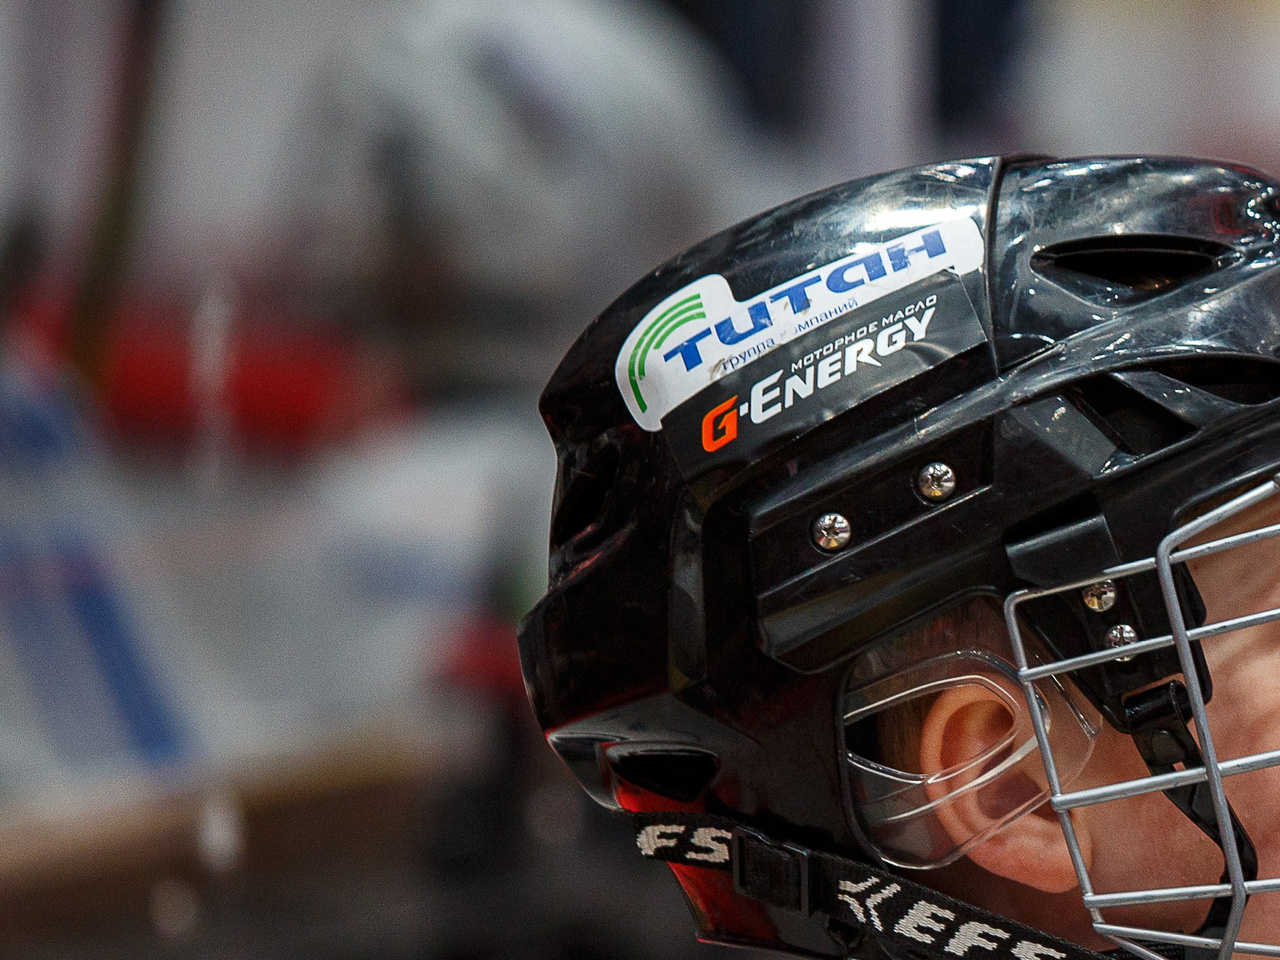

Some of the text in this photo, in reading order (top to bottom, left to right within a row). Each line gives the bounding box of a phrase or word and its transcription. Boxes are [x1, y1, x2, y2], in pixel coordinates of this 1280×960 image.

[721, 336, 776, 372] группа
[790, 294, 938, 373] МОТОРНОЕ МАСЛО
